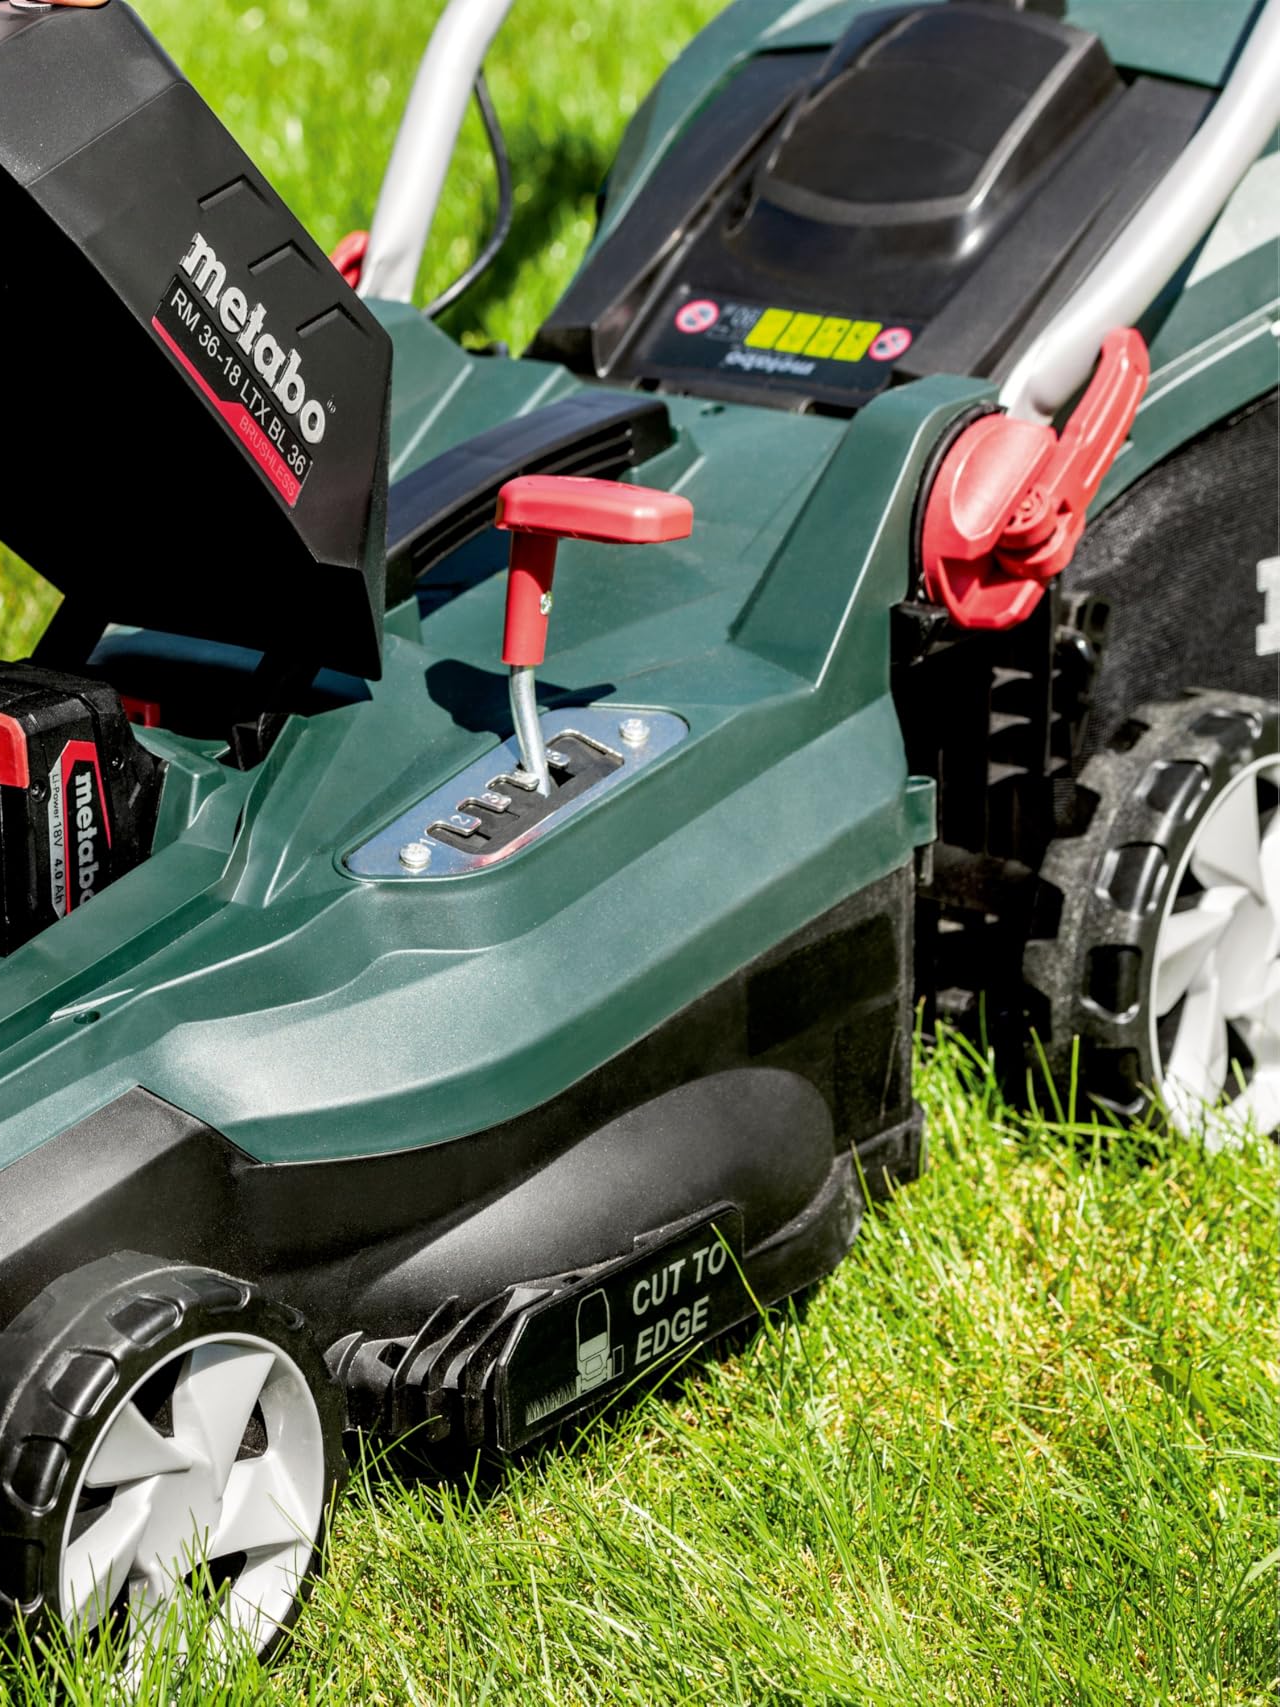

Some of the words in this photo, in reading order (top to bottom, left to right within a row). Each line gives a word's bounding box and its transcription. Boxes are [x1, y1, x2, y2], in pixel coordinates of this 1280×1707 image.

[179, 232, 326, 444] metabo
[170, 288, 201, 332] RM
[198, 325, 242, 387] 36-18
[240, 378, 273, 426] LTX
[267, 416, 286, 452] BL
[287, 445, 306, 476] 36
[239, 415, 296, 497] BRUSHLESS
[52, 773, 60, 818] Li-Power
[53, 821, 63, 847] 18V
[54, 858, 64, 880] 4.0
[55, 884, 65, 904] Ah
[632, 1258, 686, 1316] CUT
[692, 1241, 727, 1284] TO
[634, 1296, 710, 1366] EDGE
